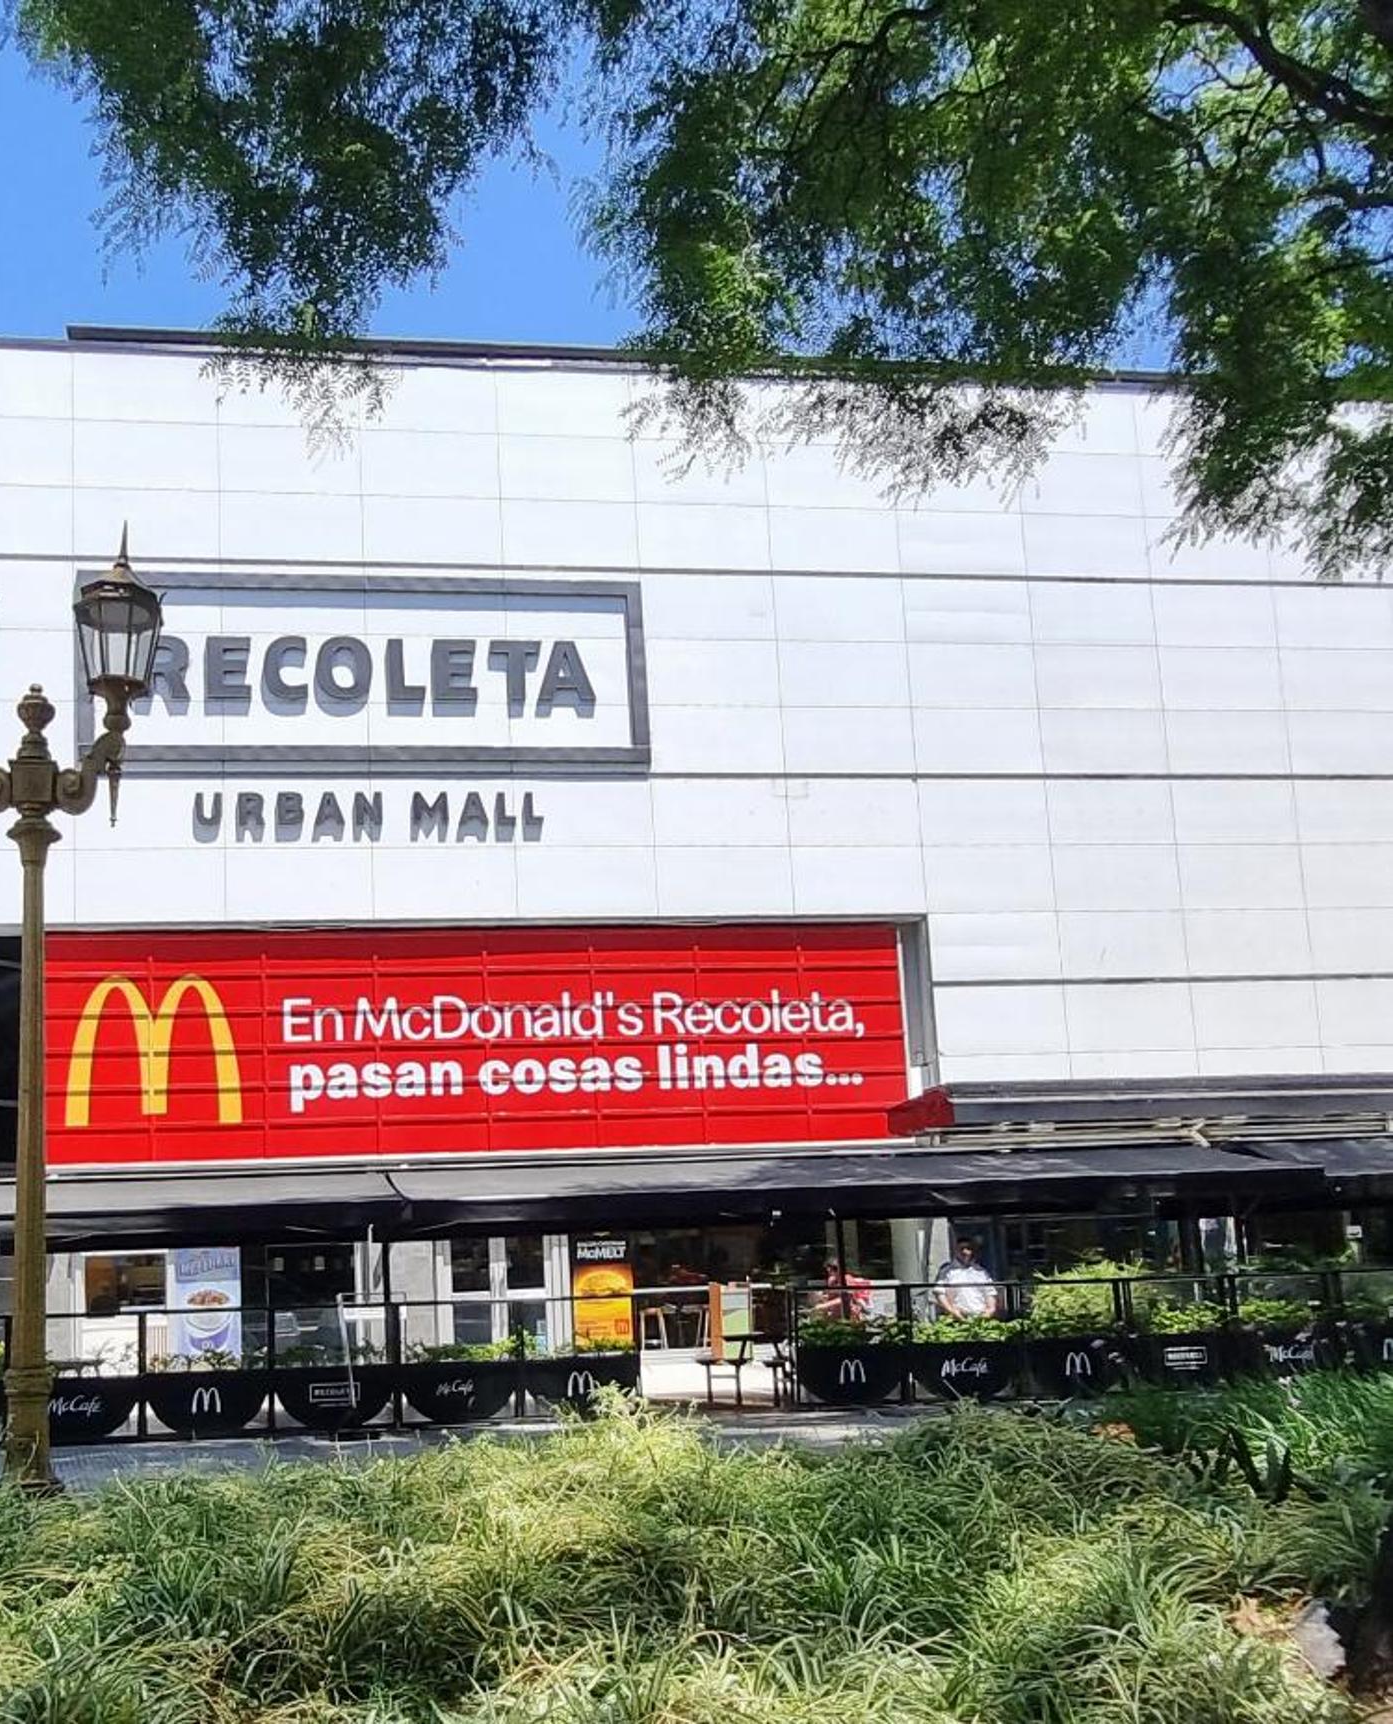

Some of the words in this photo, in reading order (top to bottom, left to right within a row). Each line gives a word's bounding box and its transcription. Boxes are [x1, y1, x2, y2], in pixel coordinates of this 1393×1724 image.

[149, 635, 596, 710] RECOLETA
[193, 791, 382, 839] URBAN
[410, 791, 544, 839] MALL
[282, 996, 344, 1042] En
[354, 990, 643, 1040] McDonald's
[651, 989, 866, 1040] Recoleta,
[288, 1061, 463, 1113] pasan
[479, 1054, 643, 1095] cosas
[657, 1043, 866, 1090] lindas...
